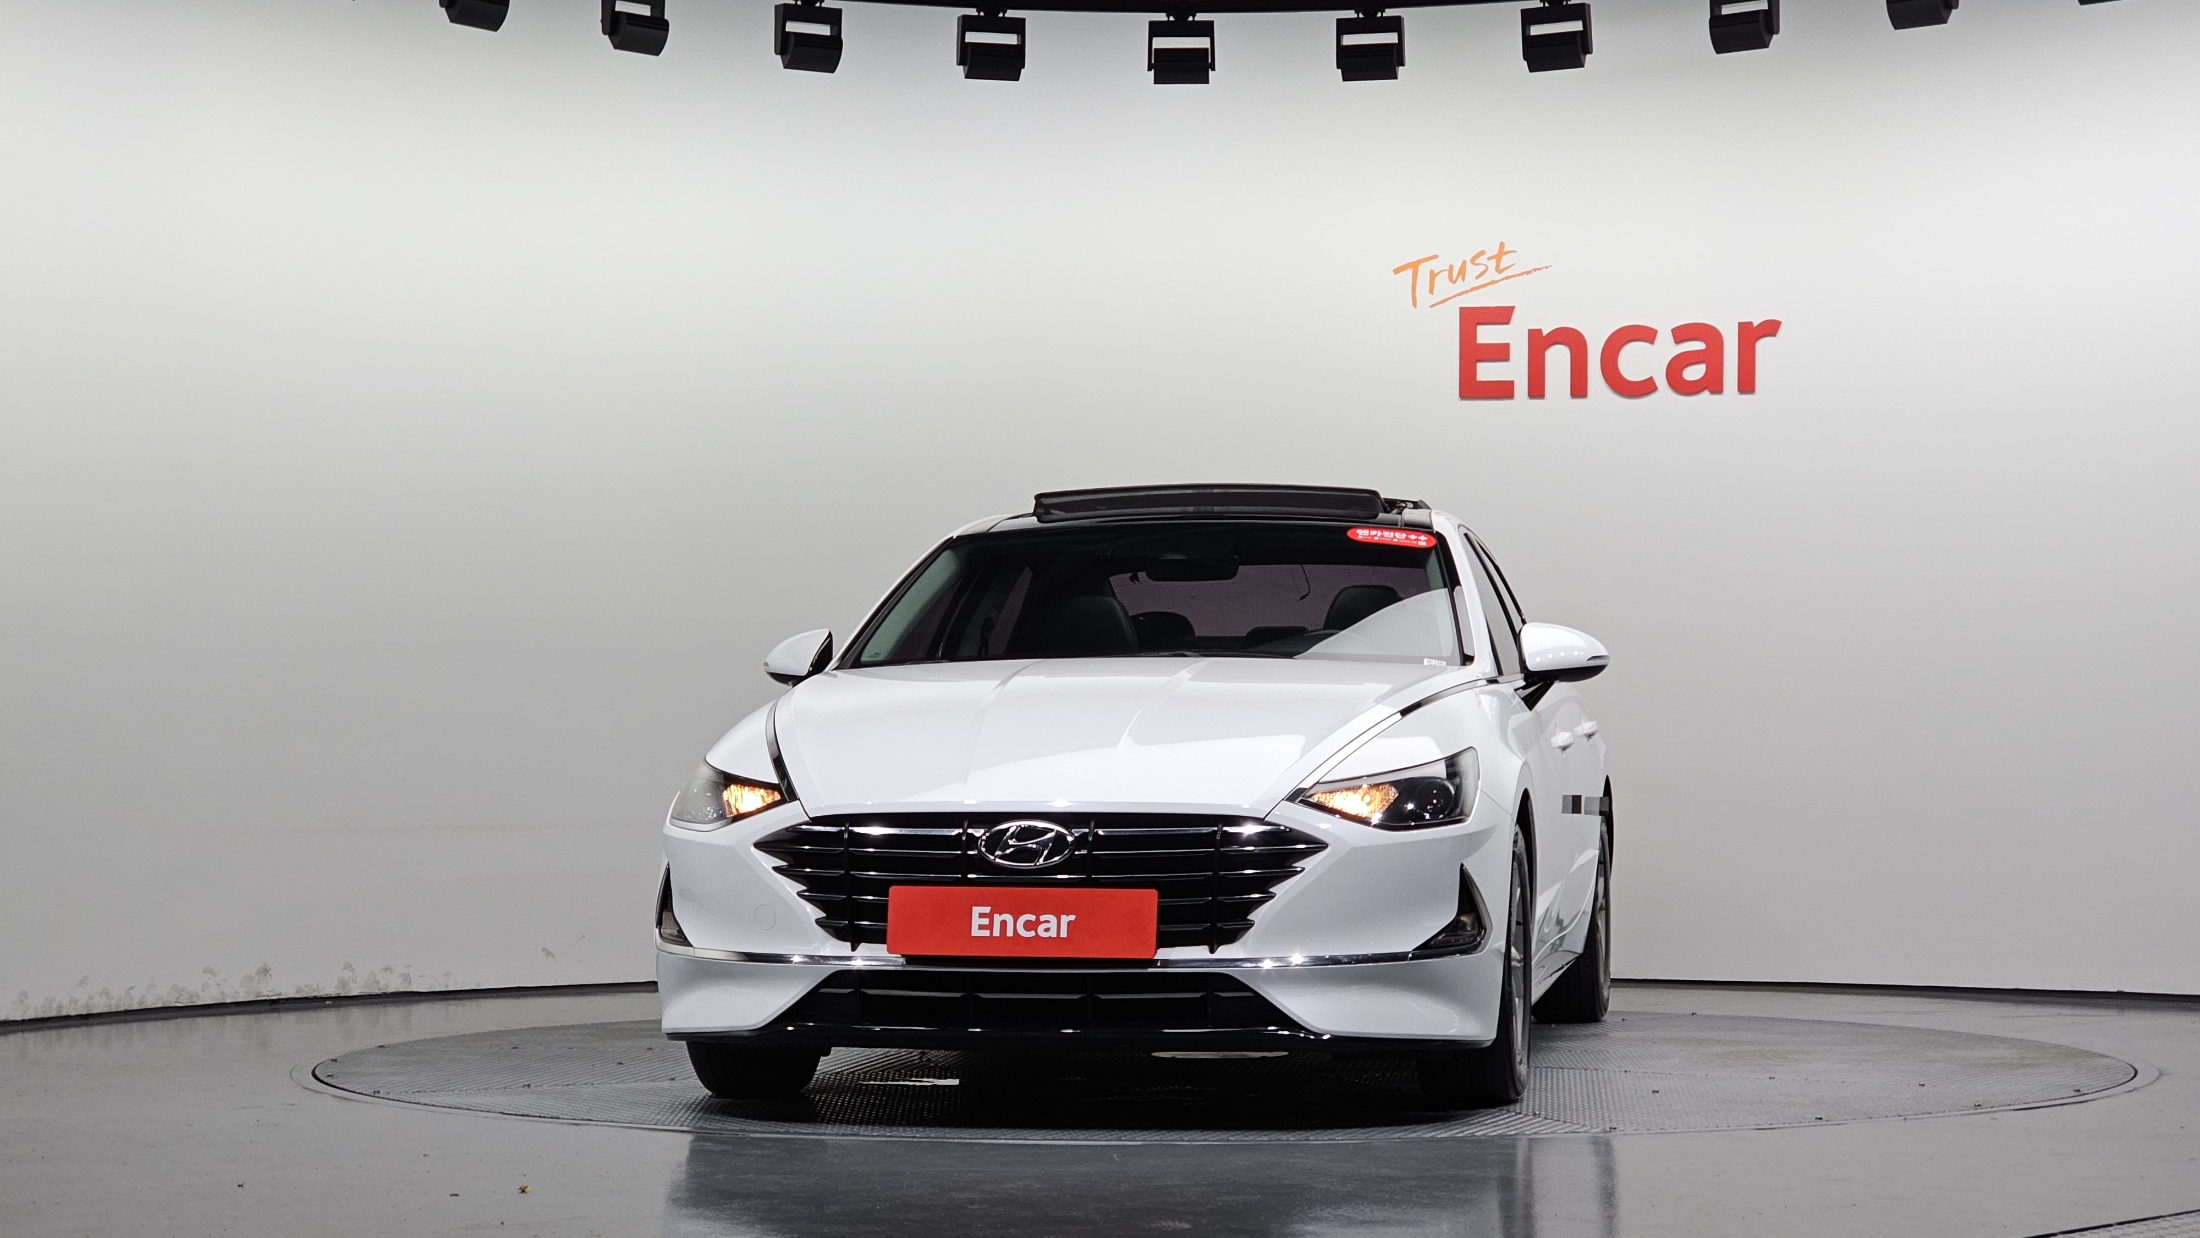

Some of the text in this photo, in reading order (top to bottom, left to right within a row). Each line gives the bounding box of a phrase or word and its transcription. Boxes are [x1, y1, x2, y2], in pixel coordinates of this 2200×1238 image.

[1393, 241, 1518, 308] Trust
[1459, 305, 1782, 400] Encar
[970, 906, 1076, 938] Encar
